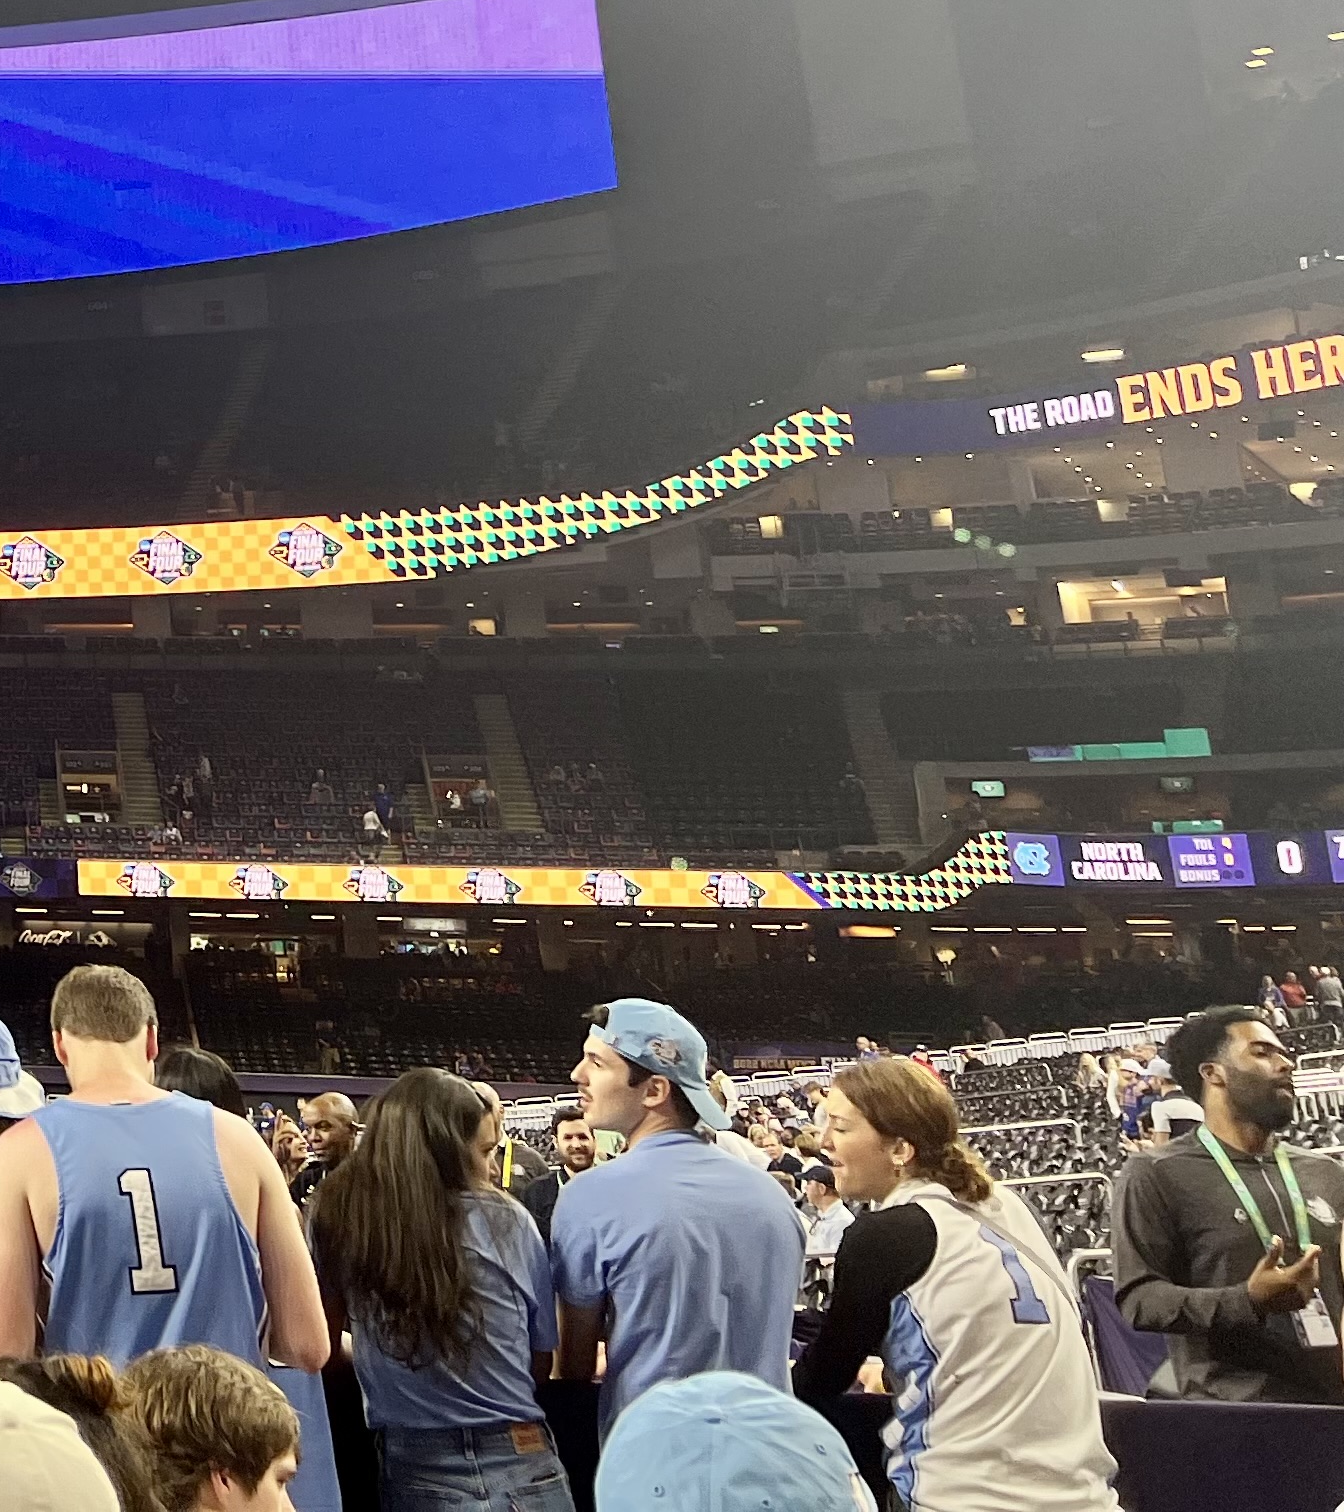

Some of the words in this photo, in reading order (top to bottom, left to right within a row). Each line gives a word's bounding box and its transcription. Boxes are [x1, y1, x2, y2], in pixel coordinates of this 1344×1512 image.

[989, 403, 1042, 434] THE
[1044, 390, 1113, 427] ROAD
[1115, 356, 1242, 424] ENDS
[150, 541, 184, 557] FINAL
[290, 533, 324, 549] FINAL
[13, 546, 46, 562] FINAL
[289, 548, 322, 565] FOUR
[12, 560, 45, 576] FOUR
[149, 555, 182, 571] FOUR
[1080, 842, 1145, 861] NORTH
[1193, 838, 1213, 850] TOL
[1180, 853, 1217, 866] FOULS
[1276, 839, 1305, 875] 0
[1071, 861, 1163, 881] CAROLINA
[1180, 869, 1221, 883] BONUS
[117, 1168, 179, 1295] 1
[978, 1224, 1051, 1324] 1
